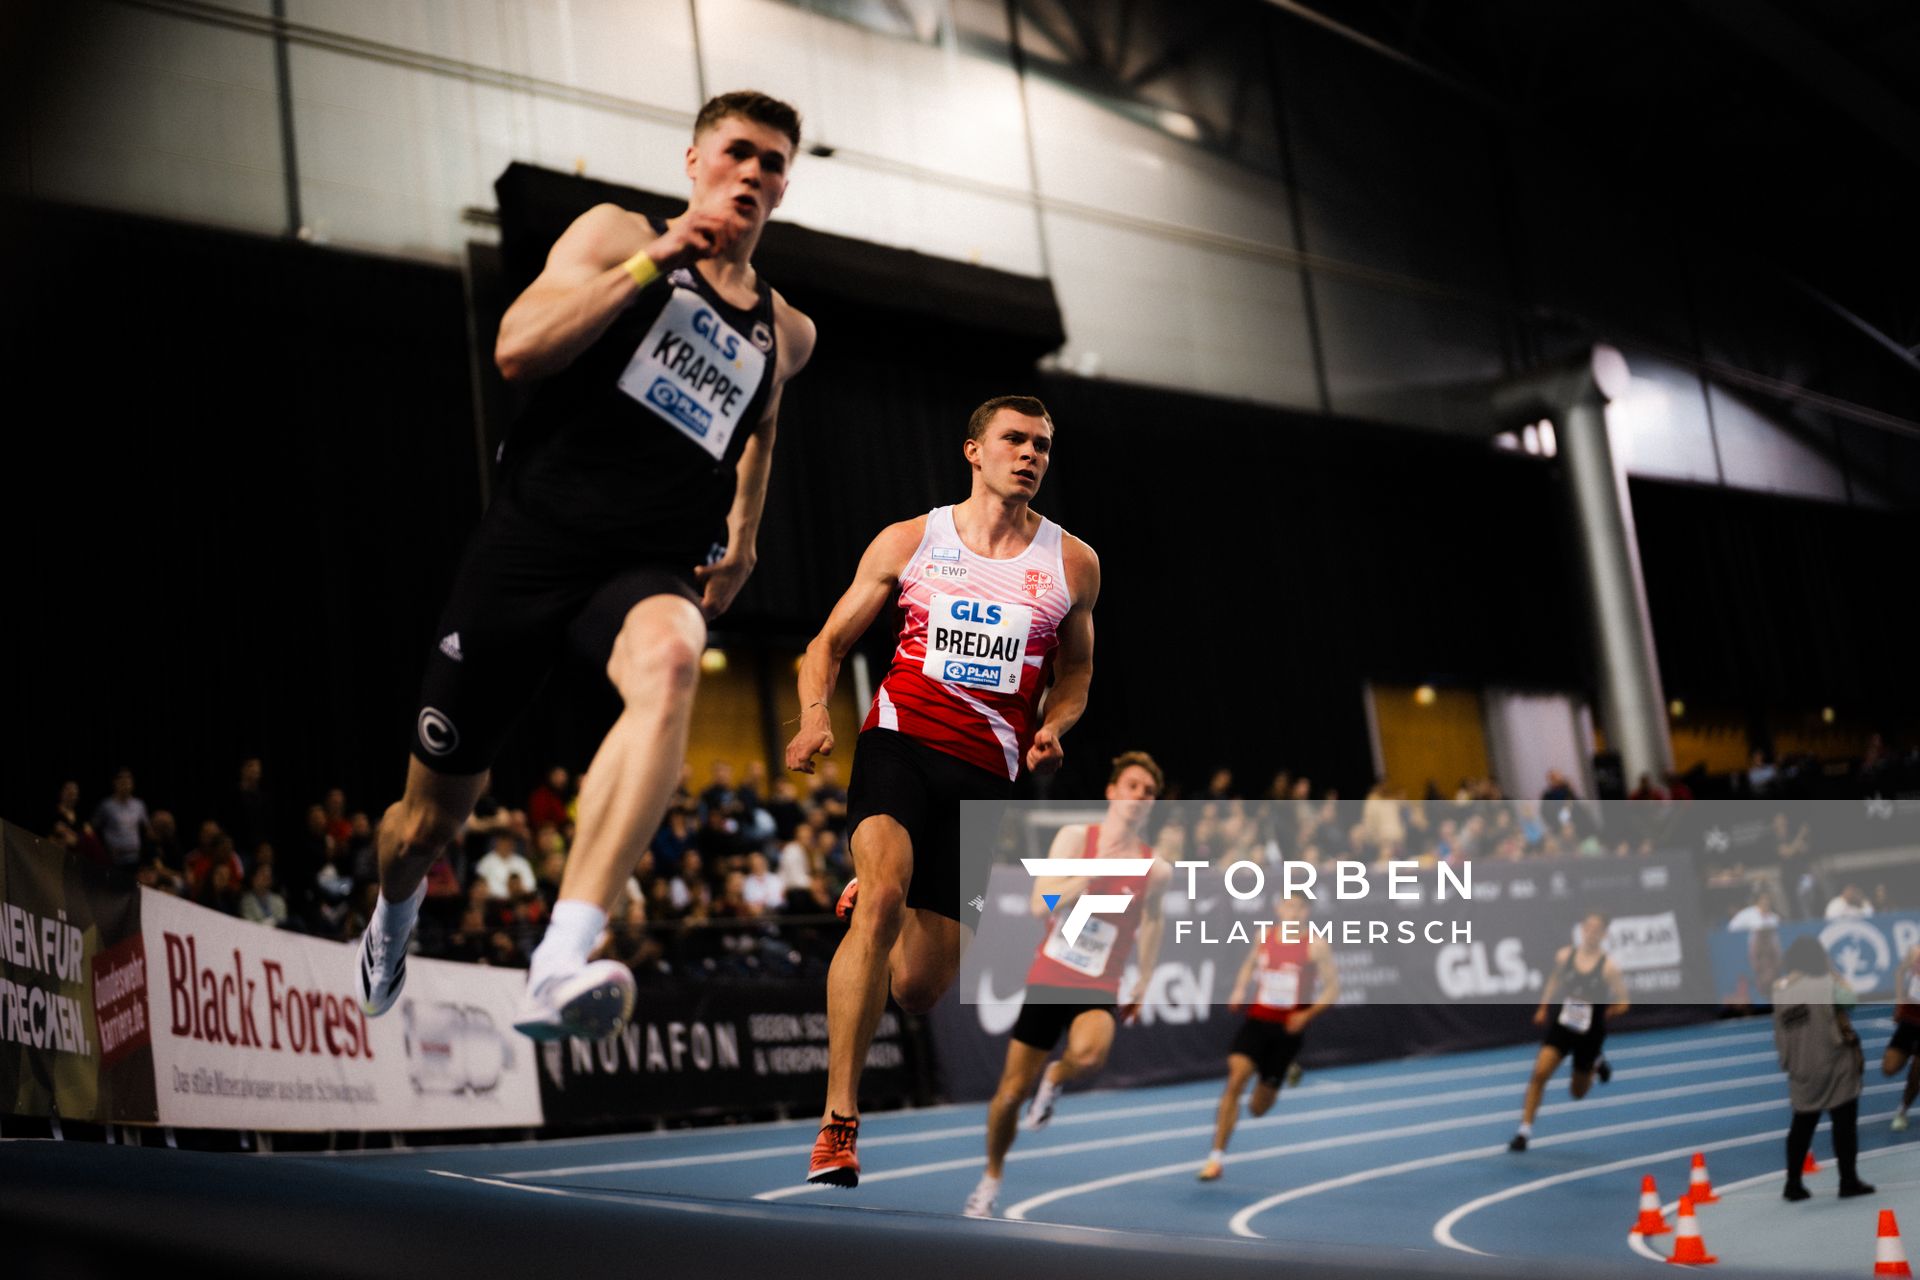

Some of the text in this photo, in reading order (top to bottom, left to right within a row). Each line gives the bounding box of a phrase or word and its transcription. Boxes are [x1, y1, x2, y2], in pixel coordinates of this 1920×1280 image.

[652, 331, 743, 417] KRAPPE
[941, 565, 967, 577] EWP
[1021, 581, 1054, 591] POTSDAM
[1026, 573, 1038, 582] SC
[935, 627, 1020, 662] BREDAU
[967, 666, 999, 679] PLAN
[41, 909, 83, 984] FÜR
[163, 931, 374, 1059] Black Forest
[569, 1020, 741, 1076] NOVAFON
